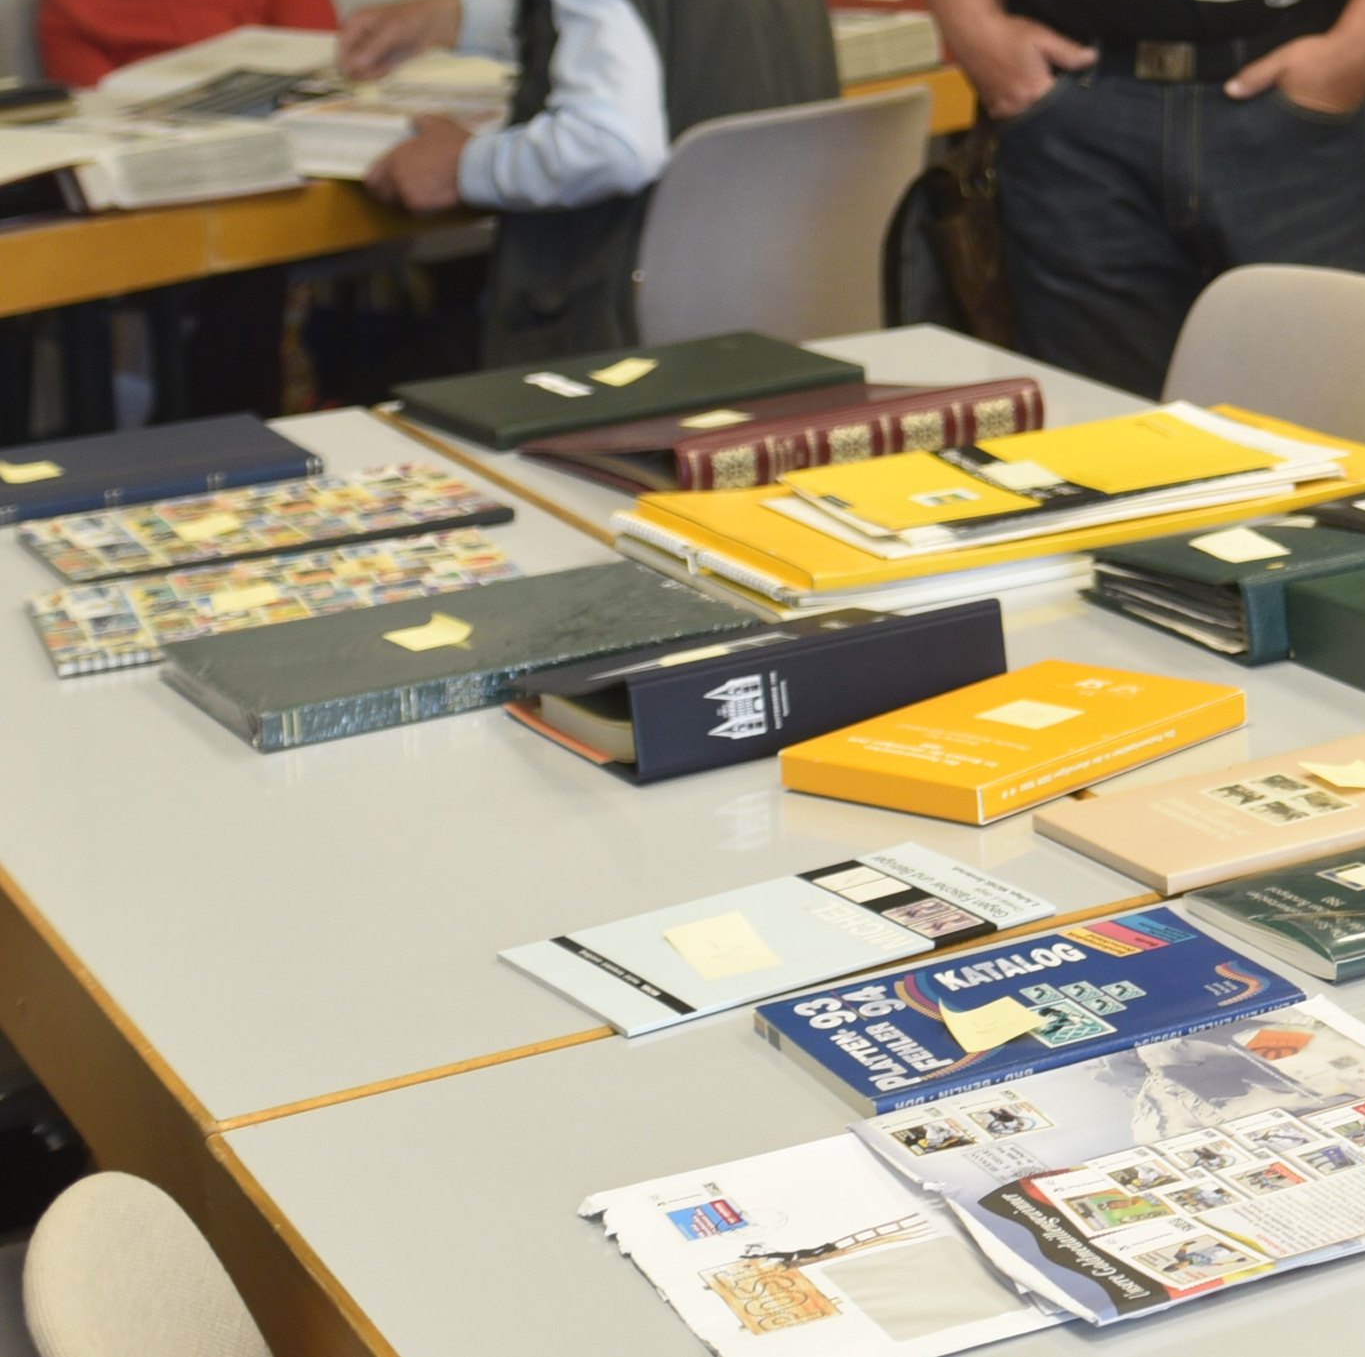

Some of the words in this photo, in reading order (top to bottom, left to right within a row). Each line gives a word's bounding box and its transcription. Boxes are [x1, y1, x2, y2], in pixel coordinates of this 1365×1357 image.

[811, 899, 915, 950] MICHEL
[933, 942, 1088, 993] KATALOG
[793, 995, 858, 1030] 93
[841, 984, 908, 1019] 94
[829, 1027, 922, 1092] PLATTEN-
[864, 1020, 954, 1073] FEHLER
